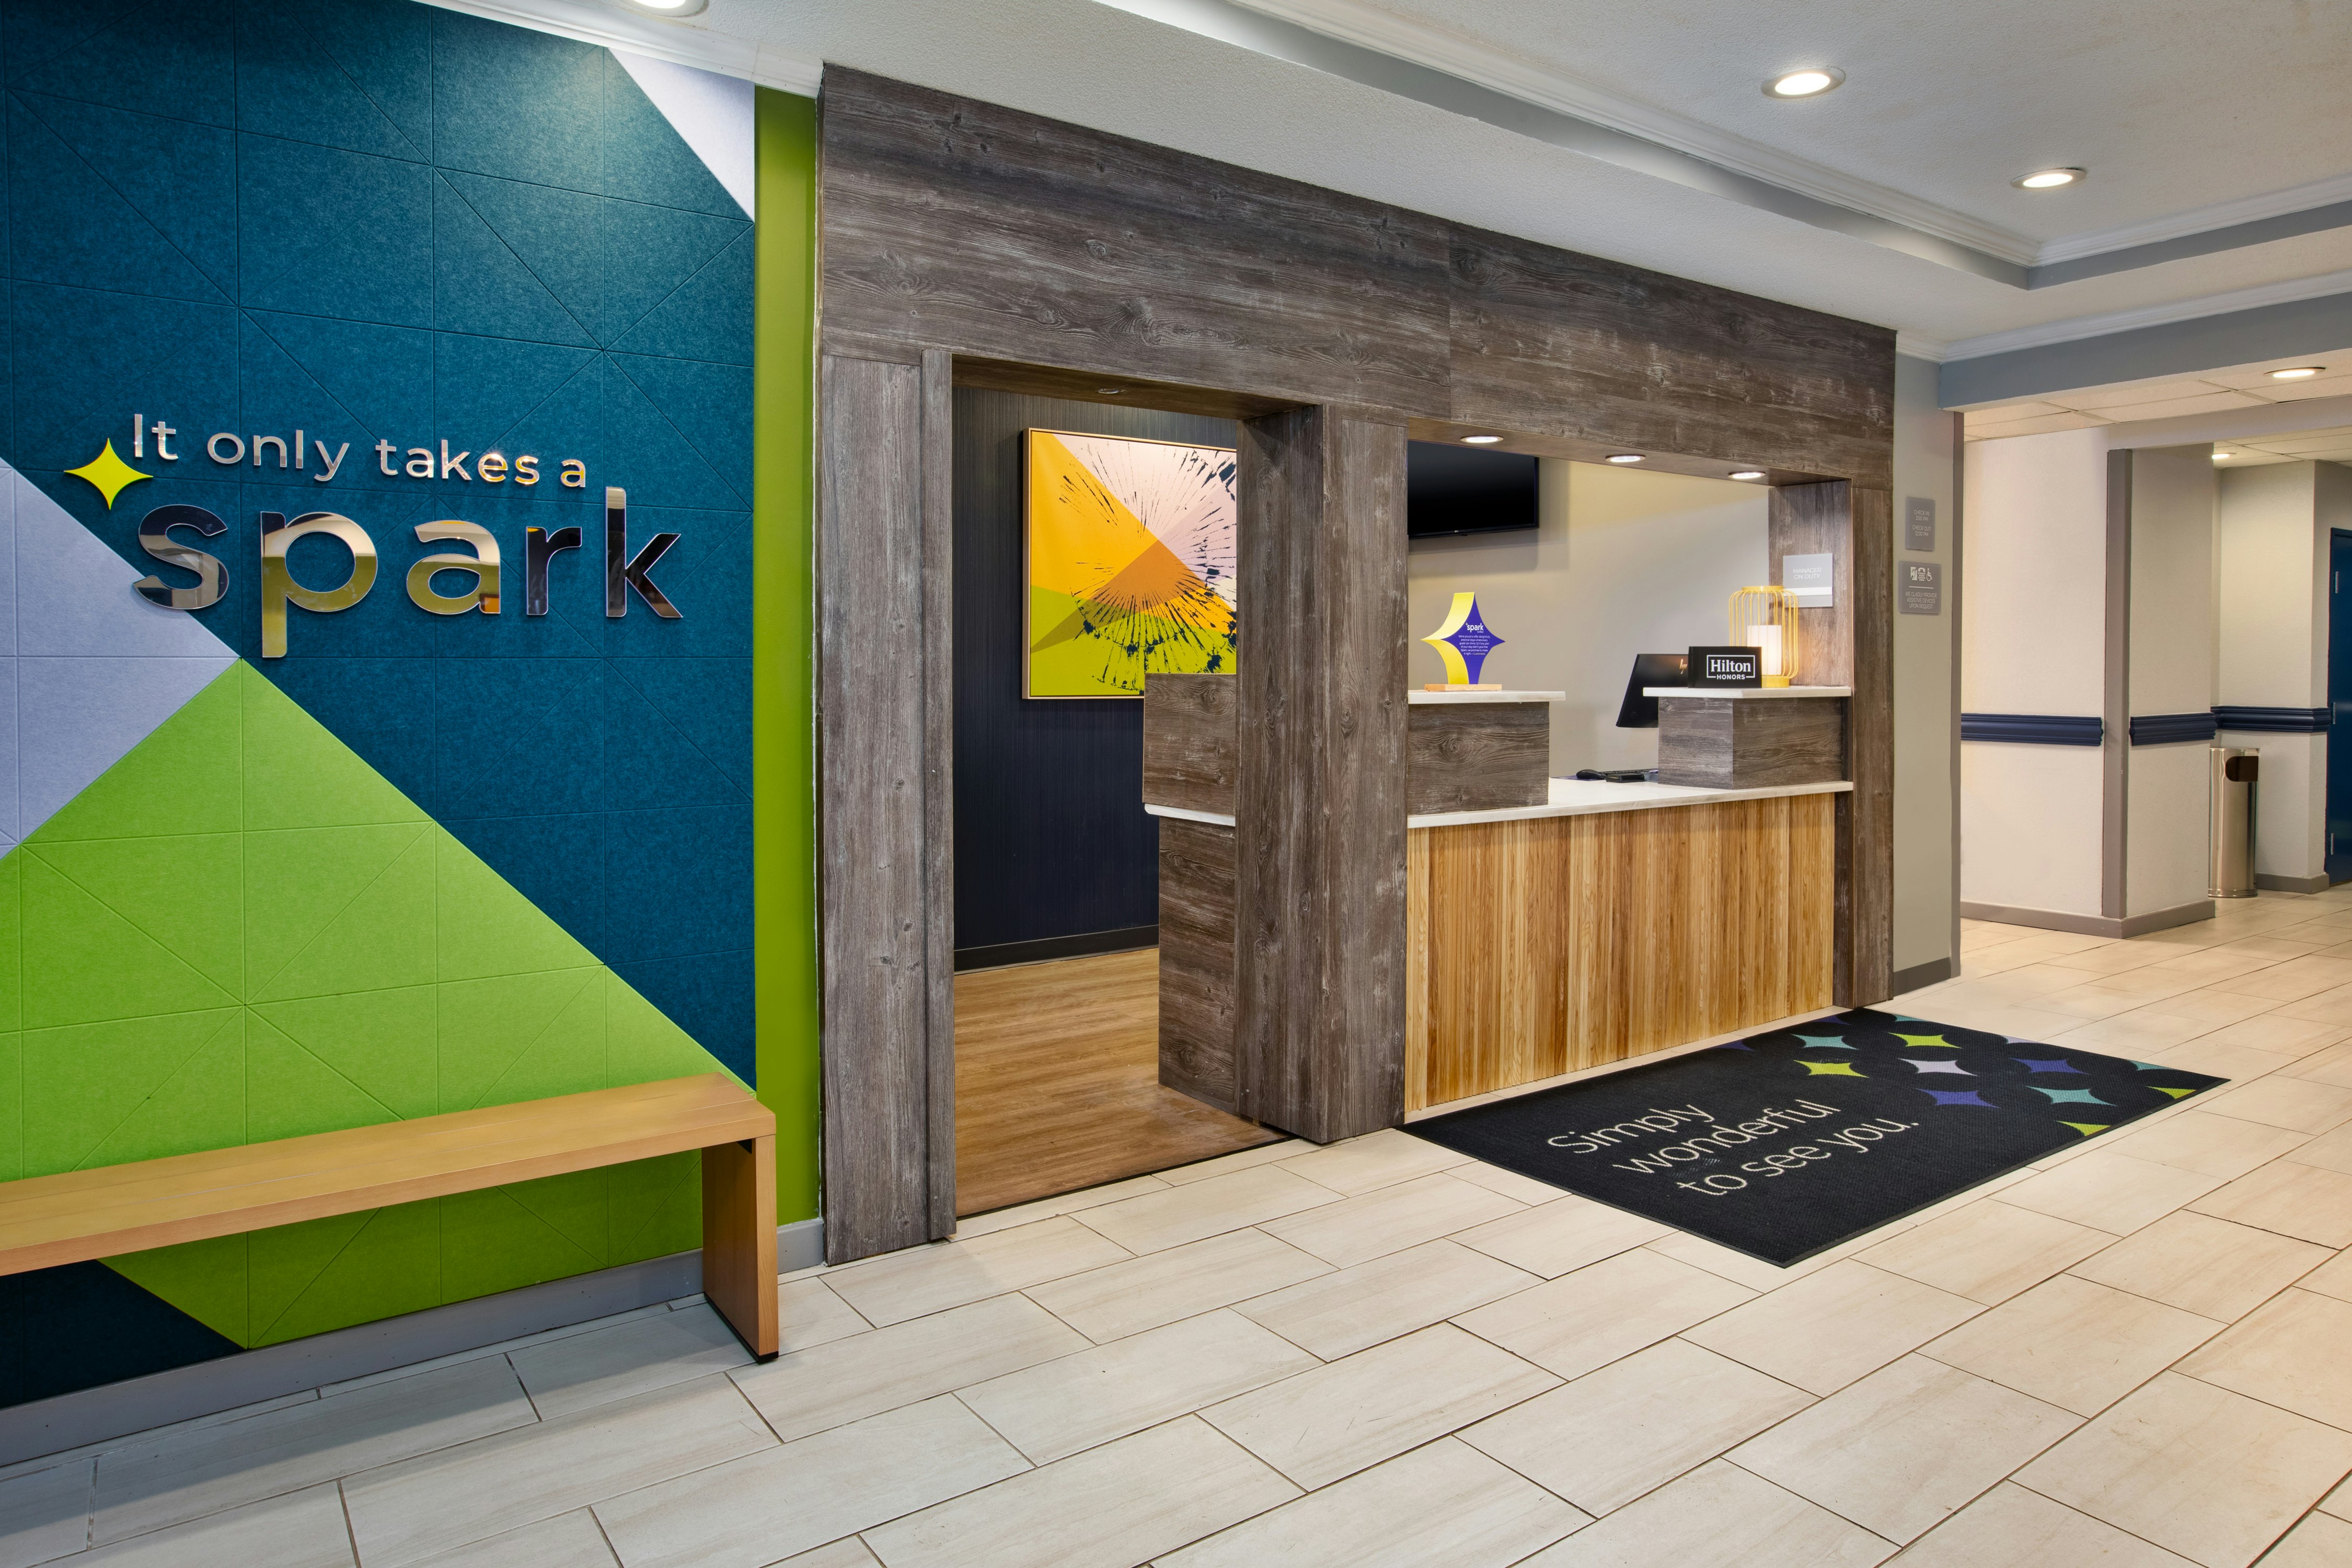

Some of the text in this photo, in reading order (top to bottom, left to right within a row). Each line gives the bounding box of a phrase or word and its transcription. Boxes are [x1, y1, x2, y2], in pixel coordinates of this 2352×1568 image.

[134, 413, 586, 488] It only takes a
[132, 486, 683, 658] spark
[1467, 622, 1484, 632] spark
[1711, 659, 1751, 672] Hilton
[1548, 1104, 1714, 1153] Simply
[1612, 1099, 1841, 1173] wonderful
[1676, 1118, 1919, 1196] to see you.
